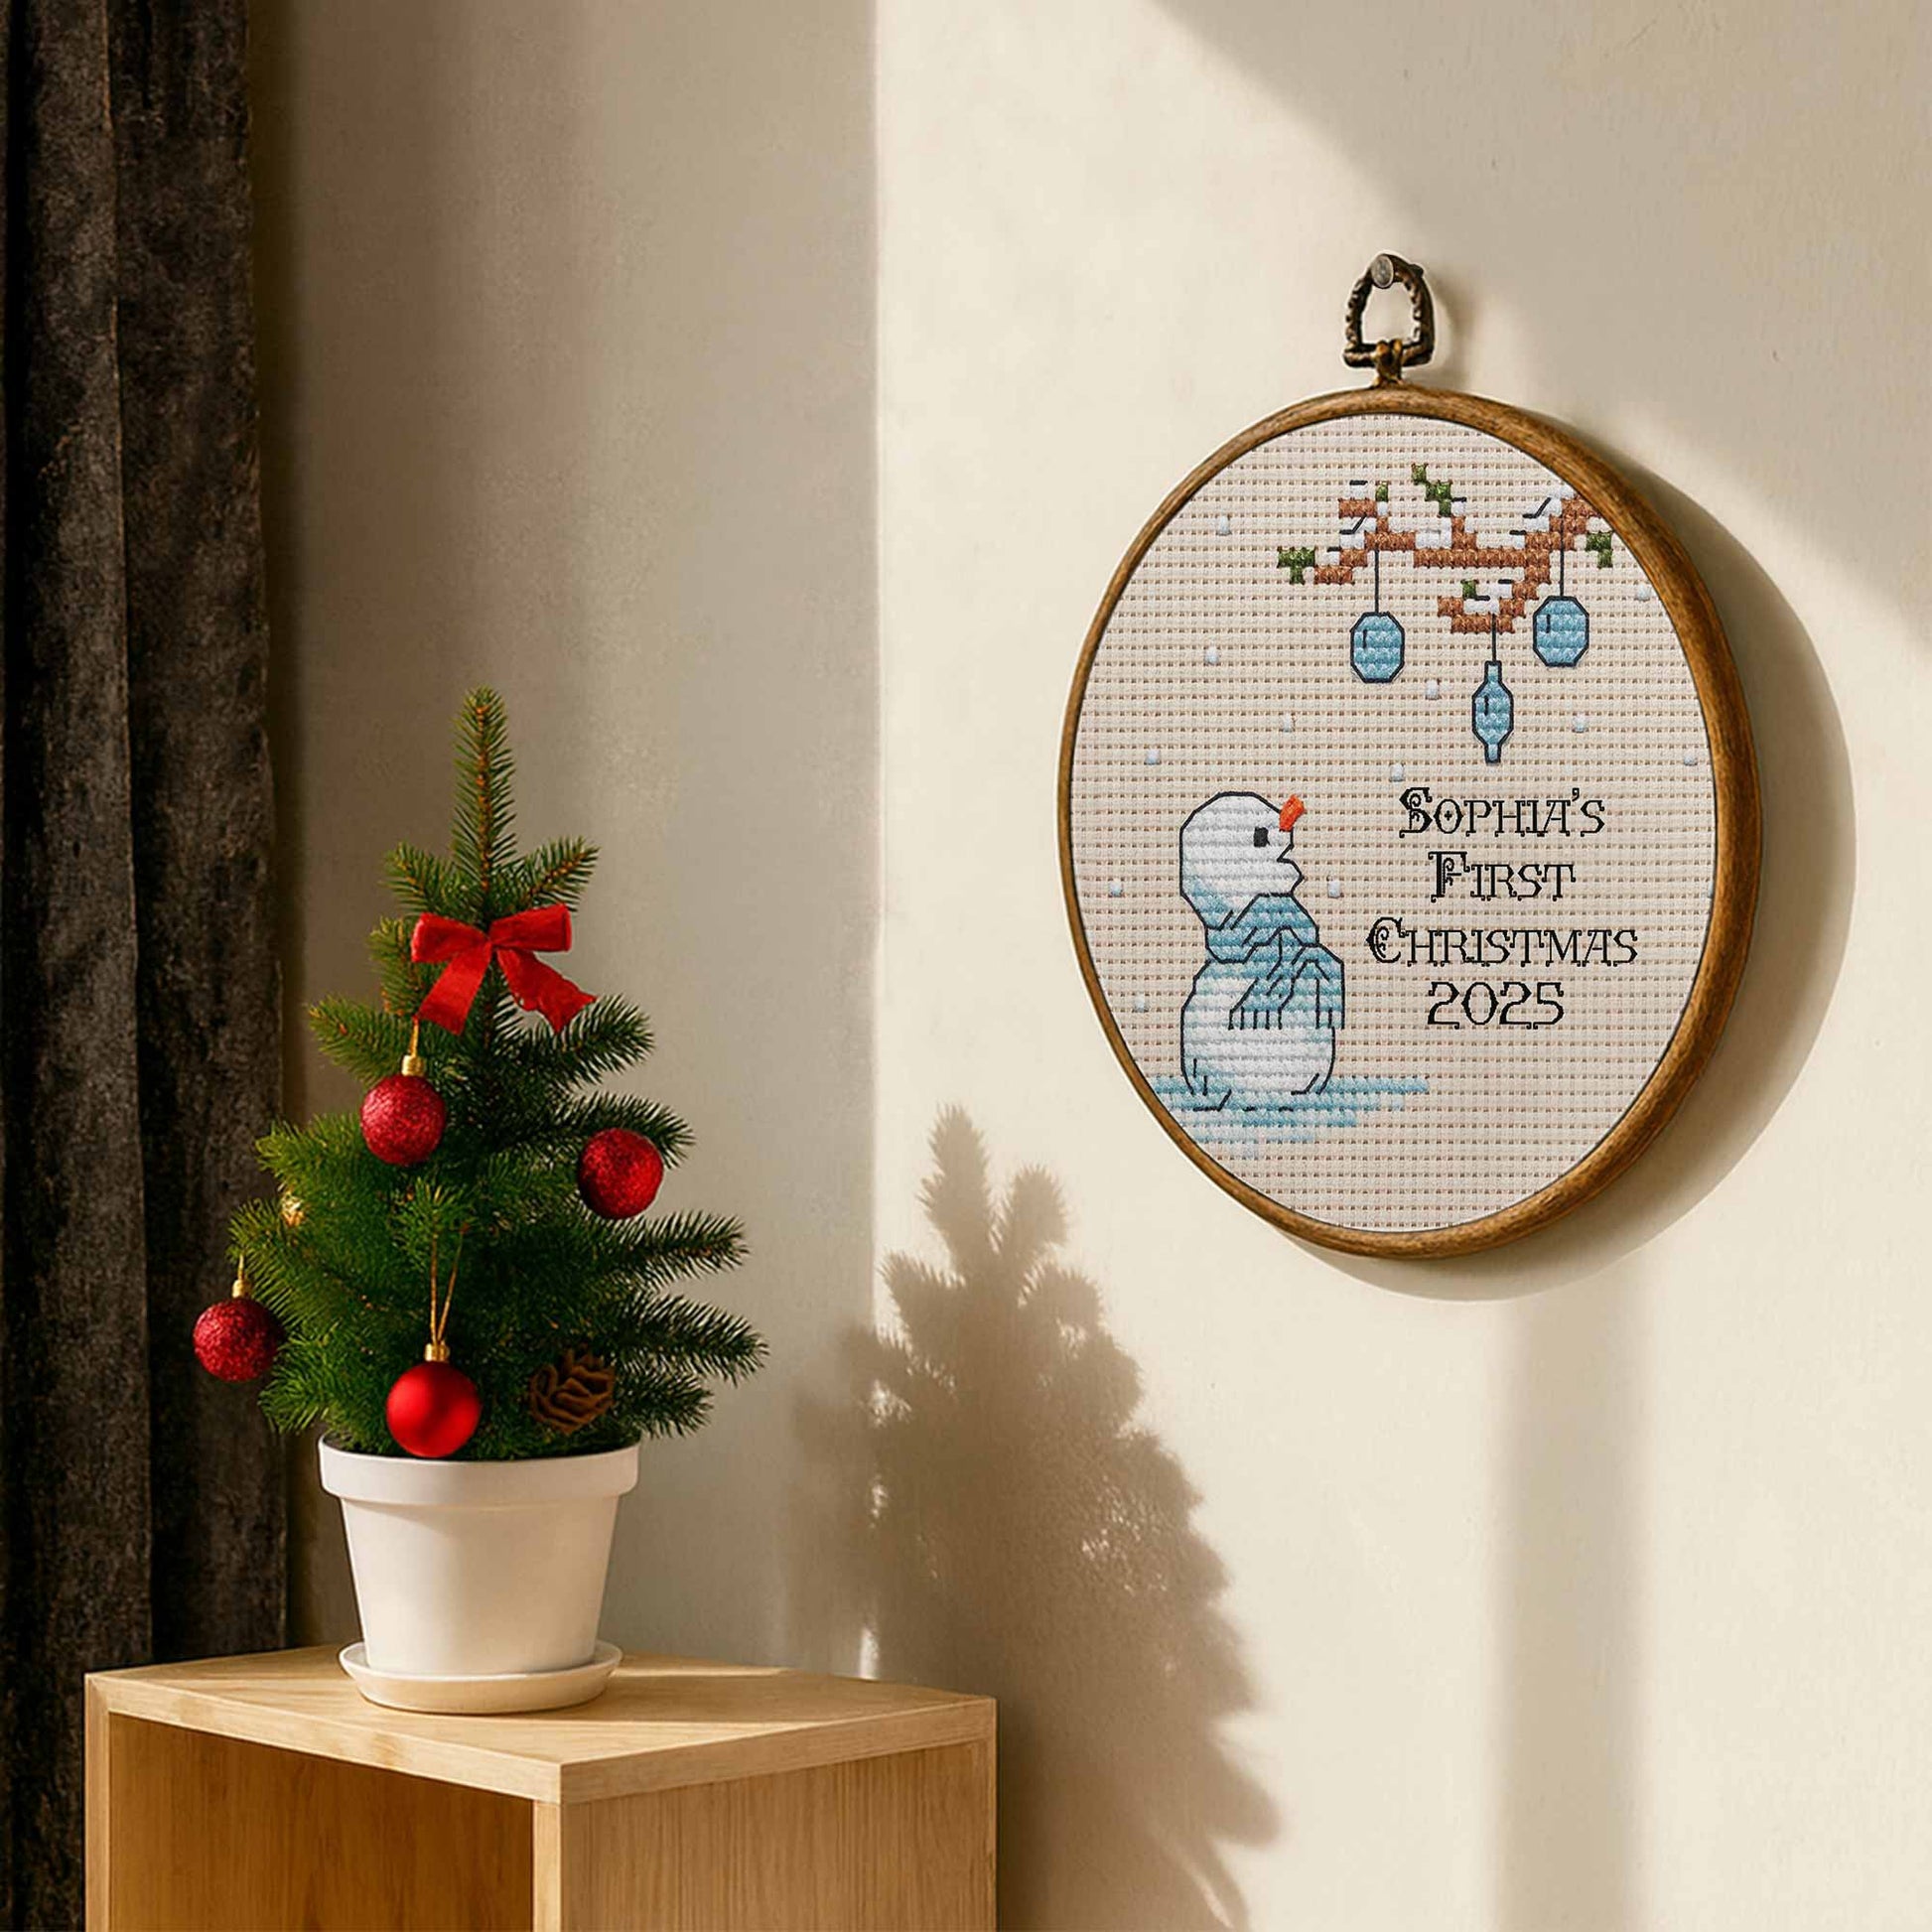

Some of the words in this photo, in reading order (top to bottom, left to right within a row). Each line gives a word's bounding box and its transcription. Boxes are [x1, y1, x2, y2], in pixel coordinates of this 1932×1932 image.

[1399, 787, 1605, 838] SOPHIA'S
[1428, 851, 1577, 902] FIRST
[1365, 916, 1638, 967] CHRISTMAS
[1427, 981, 1565, 1030] 2025
